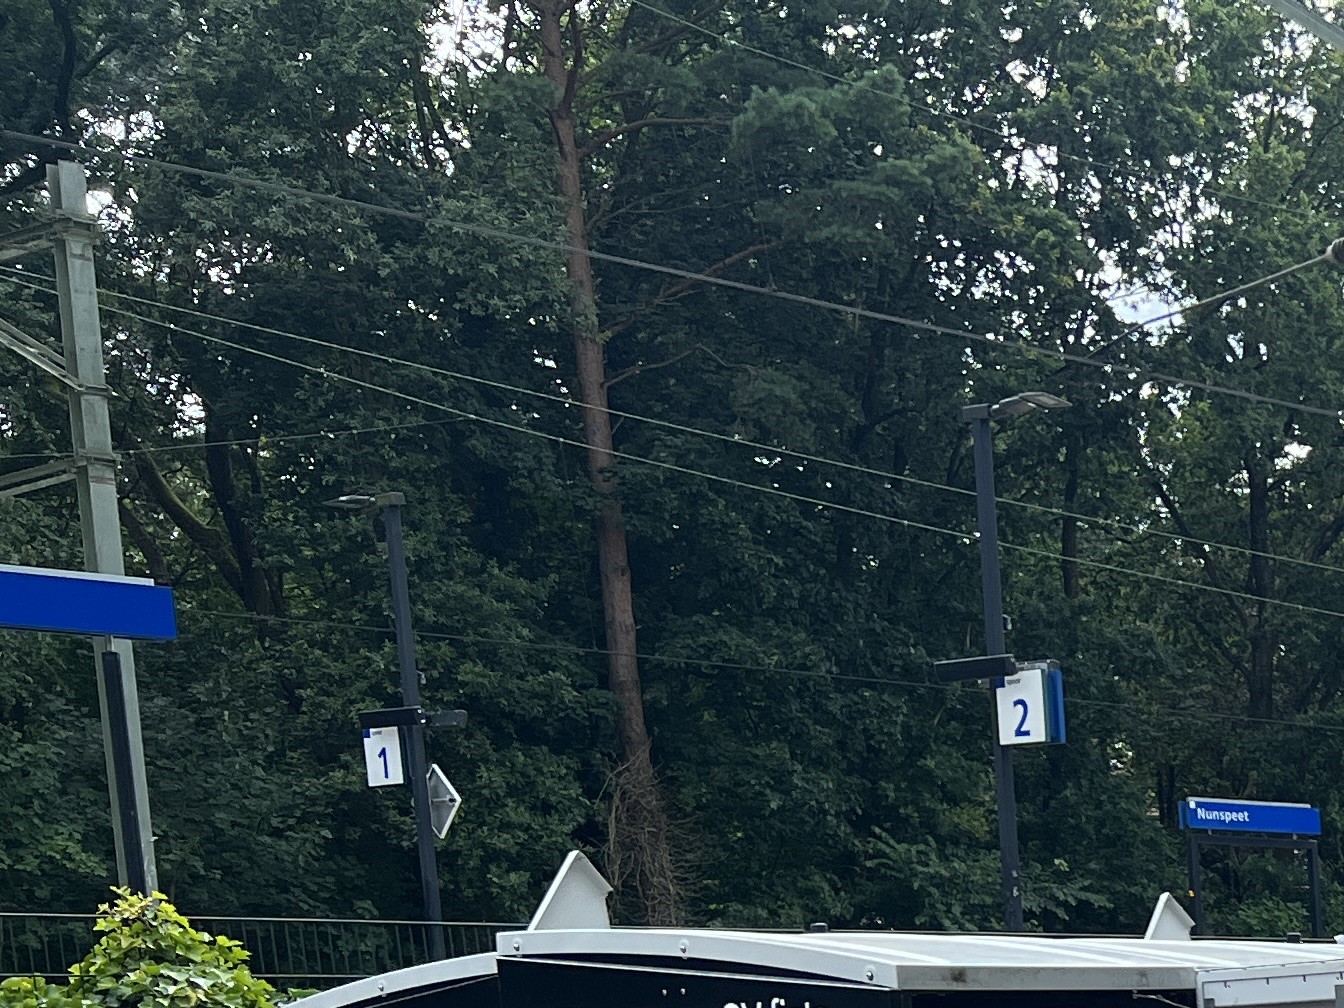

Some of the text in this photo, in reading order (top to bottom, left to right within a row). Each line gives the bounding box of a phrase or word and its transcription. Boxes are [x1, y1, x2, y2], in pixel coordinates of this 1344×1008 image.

[1013, 698, 1031, 738] 2
[377, 747, 389, 779] 1
[1197, 807, 1249, 824] Nunspeet
